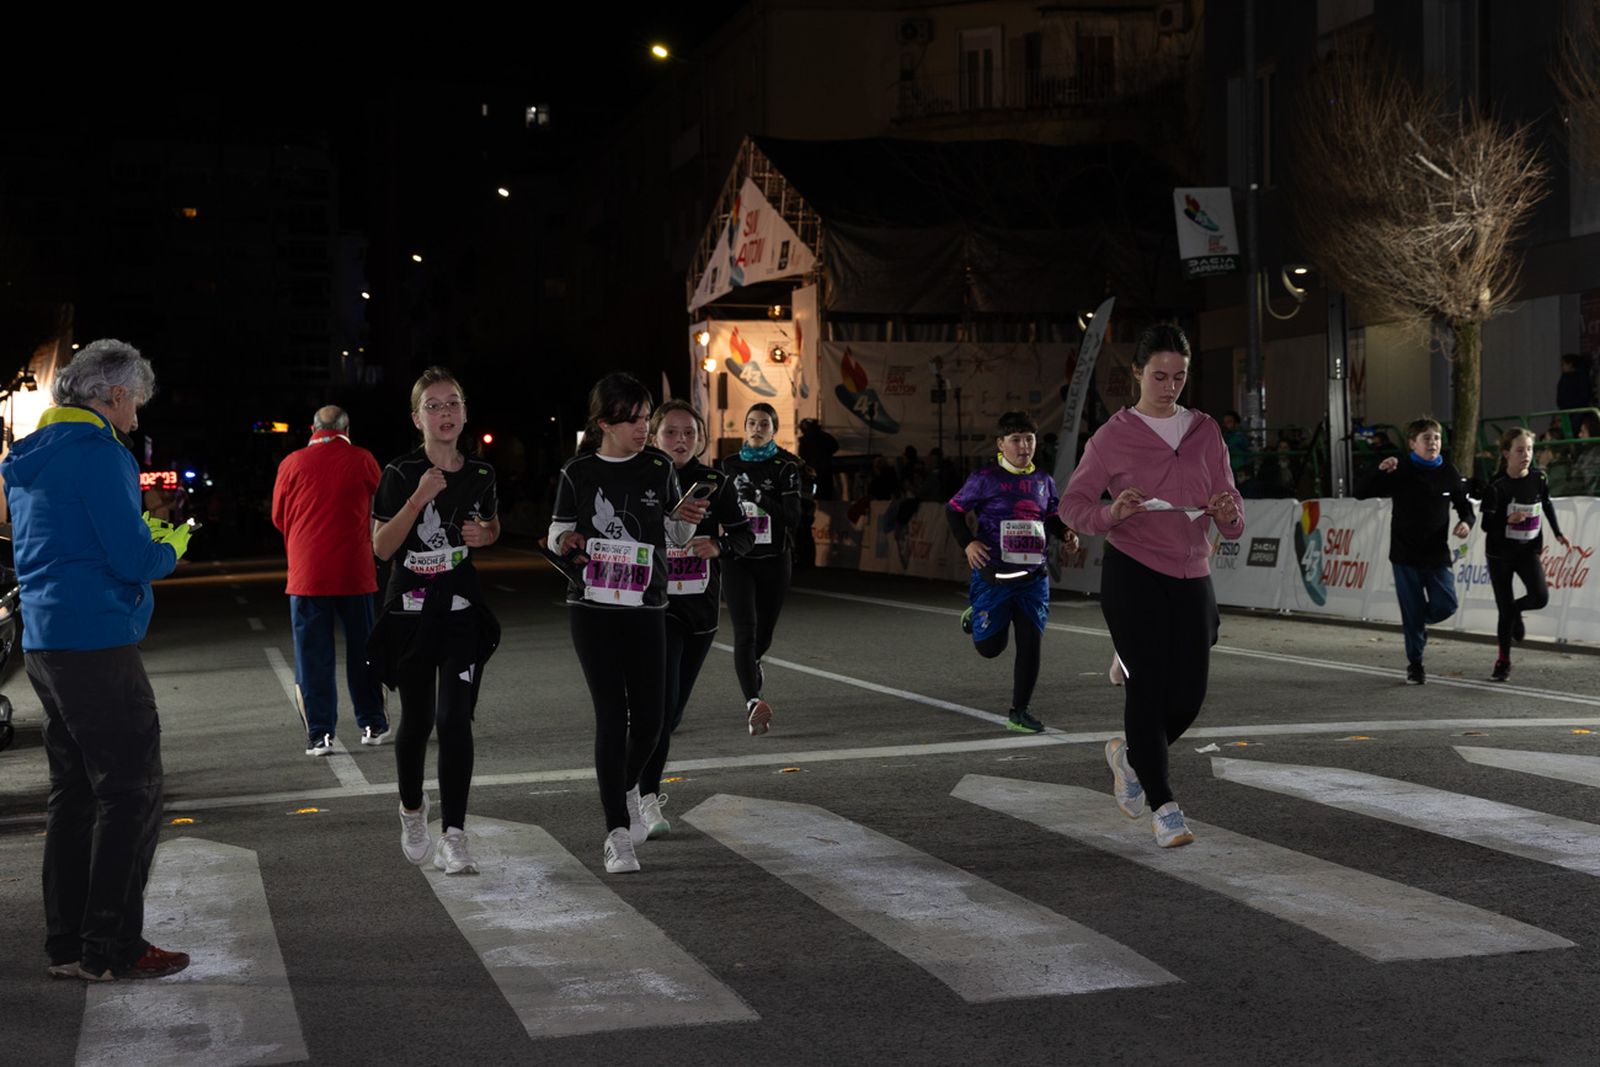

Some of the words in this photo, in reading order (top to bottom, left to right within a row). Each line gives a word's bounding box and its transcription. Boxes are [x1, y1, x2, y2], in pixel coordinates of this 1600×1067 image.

[1188, 257, 1235, 267] DACIA
[605, 521, 623, 539] 43
[427, 532, 445, 549] 43
[1324, 528, 1354, 556] SAN
[417, 557, 439, 566] NOCHE
[592, 552, 607, 560] SAN
[1301, 540, 1321, 582] 43
[1320, 553, 1369, 589] ANTÓN
[1457, 564, 1491, 591] aqua
